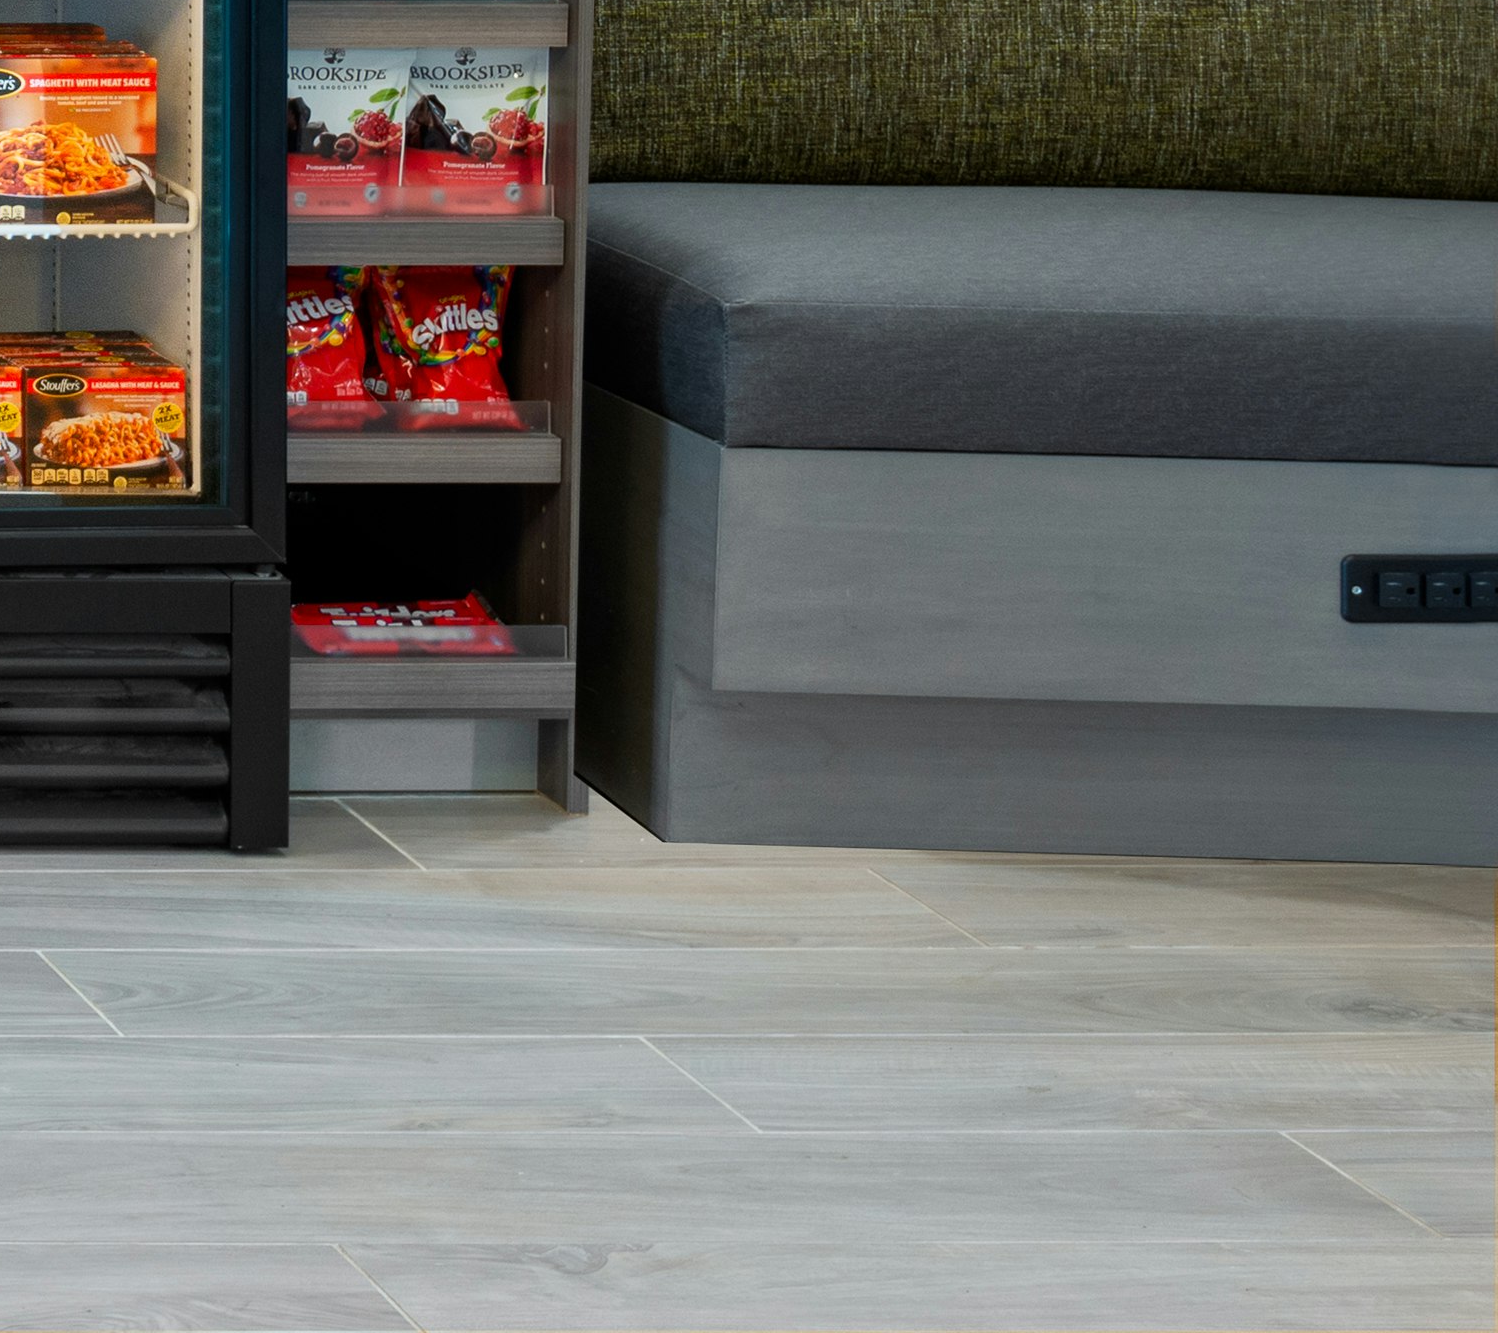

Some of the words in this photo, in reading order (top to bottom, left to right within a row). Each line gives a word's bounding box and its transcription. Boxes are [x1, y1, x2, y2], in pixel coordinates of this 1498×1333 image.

[410, 64, 524, 82] BROOKSIDE
[29, 78, 73, 88] SPAGHETTI
[75, 78, 97, 88] WITH
[100, 78, 122, 87] MEAT
[124, 78, 151, 87] SAUCE
[412, 303, 499, 349] Skittles
